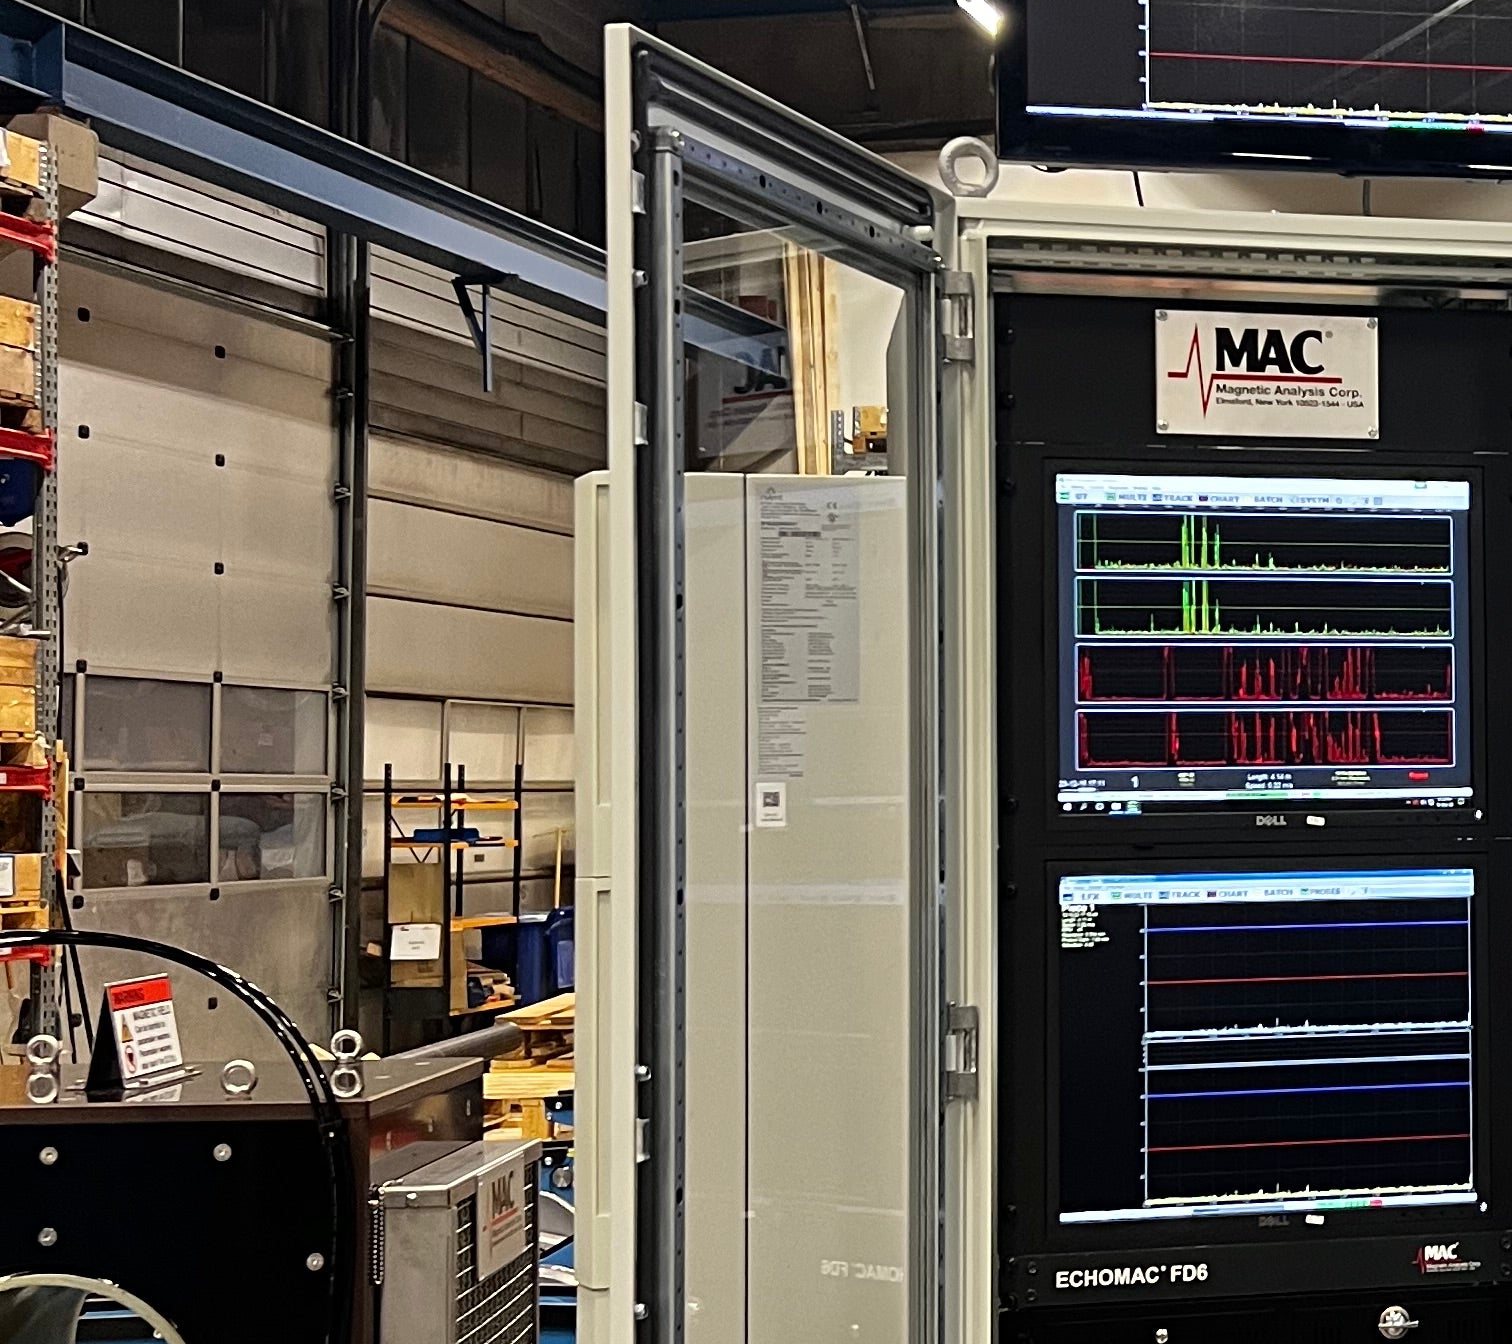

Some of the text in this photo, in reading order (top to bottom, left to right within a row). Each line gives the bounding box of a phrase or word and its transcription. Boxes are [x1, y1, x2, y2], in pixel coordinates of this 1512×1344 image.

[1215, 327, 1324, 375] MAC
[1216, 384, 1362, 398] Magnetic Analysis Corp.
[1130, 775, 1140, 788] 1
[1247, 773, 1266, 782] Length
[1255, 816, 1287, 826] DELL
[1258, 1215, 1289, 1227] DELL
[1425, 1244, 1457, 1261] MAC
[1055, 1264, 1208, 1288] ECHOMAC FD6
